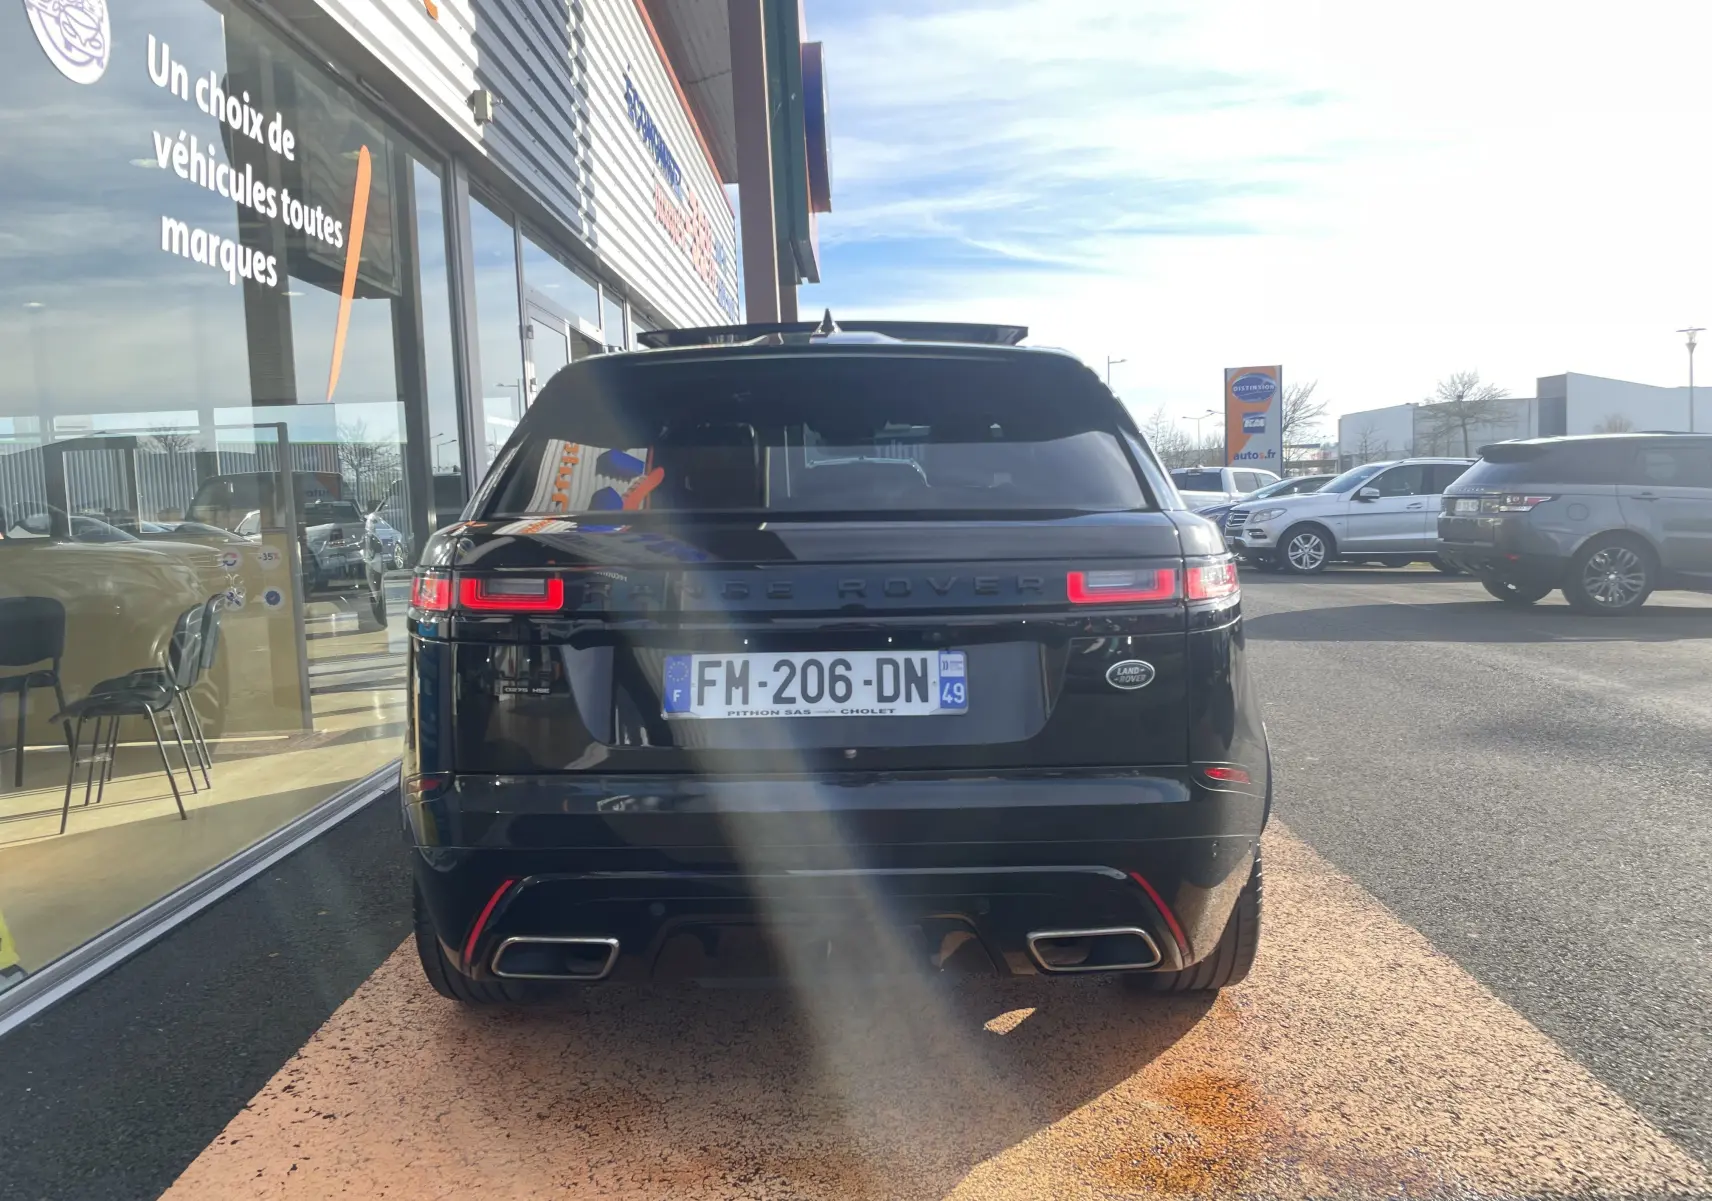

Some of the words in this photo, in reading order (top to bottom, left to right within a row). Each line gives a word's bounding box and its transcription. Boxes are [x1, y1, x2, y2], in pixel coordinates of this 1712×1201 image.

[148, 33, 189, 101] Un
[195, 70, 264, 144] choix
[268, 111, 296, 161] de
[153, 129, 277, 218] véhicules
[280, 187, 344, 248] toutes
[161, 215, 278, 287] marques
[1233, 449, 1276, 461] autos.fr
[837, 575, 1045, 599] ROVER
[696, 657, 930, 706] FM-206-DN
[1117, 666, 1140, 676] LAND
[1119, 674, 1146, 683] ROVER
[672, 689, 681, 702] F
[942, 682, 965, 704] 49
